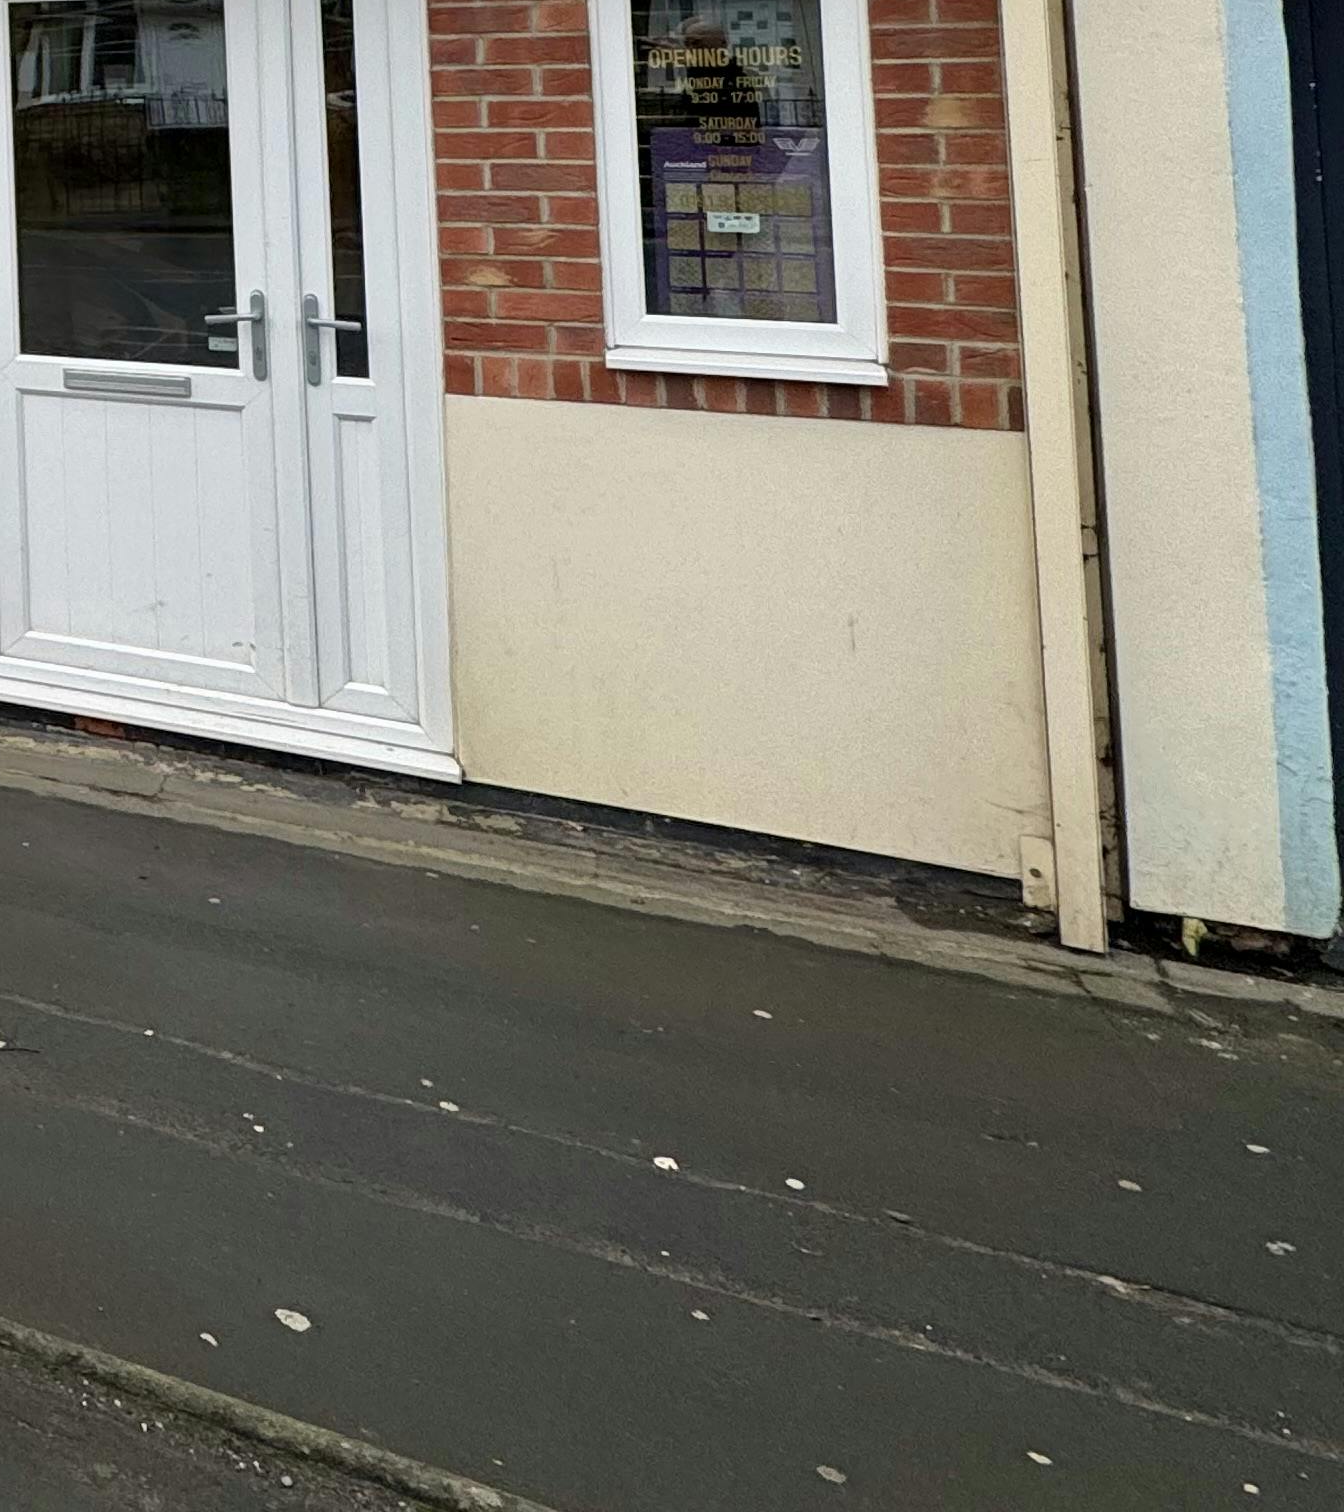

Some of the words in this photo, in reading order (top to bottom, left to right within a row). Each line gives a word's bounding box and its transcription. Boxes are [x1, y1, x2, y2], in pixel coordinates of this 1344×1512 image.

[648, 47, 729, 69] OPENING
[735, 45, 802, 66] HOURS
[675, 76, 725, 91] MONDAY
[736, 76, 777, 88] FRIDAY
[731, 90, 763, 103] 17:00
[699, 116, 756, 130] SATURDAY
[663, 160, 707, 169] Auckland
[708, 154, 753, 167] SUNDAY
